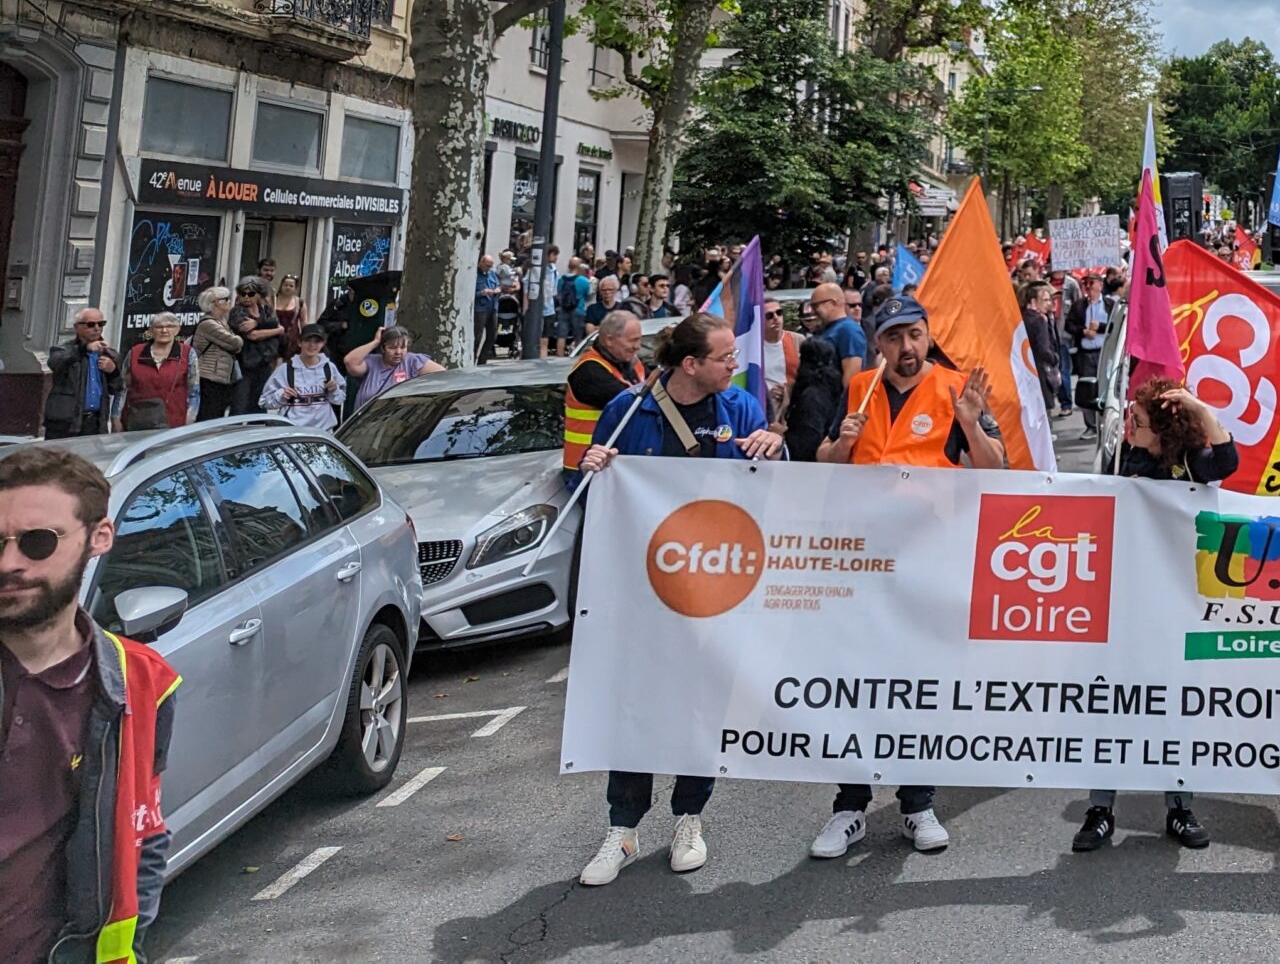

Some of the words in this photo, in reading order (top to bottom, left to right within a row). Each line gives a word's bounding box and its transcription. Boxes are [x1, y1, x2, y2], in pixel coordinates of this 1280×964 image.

[206, 174, 217, 198] À
[219, 181, 258, 202] LOUER
[263, 188, 298, 205] Cellules
[299, 191, 354, 209] Commerciales
[355, 196, 399, 213] DIVISIBLES
[336, 235, 362, 252] Place
[998, 505, 1097, 542] la
[770, 535, 802, 549] UTI
[809, 537, 866, 552] LOIRE
[767, 556, 895, 573] HAUTE-LOIRE
[990, 532, 1097, 593] cgt
[763, 599, 781, 610] AGIR
[781, 599, 801, 610] POUR
[802, 599, 821, 610] TOUS
[765, 585, 803, 596] S'ENGAGER
[804, 586, 824, 597] POUR
[825, 586, 854, 598] CHACUN
[990, 594, 1092, 634] loire
[774, 677, 940, 710] CONTRE
[952, 675, 1168, 715] L'EXTRÊME
[720, 729, 811, 759] POUR
[821, 733, 863, 759] LA
[874, 734, 1083, 763] DEMOCRATIE
[1094, 739, 1133, 765] ET
[1143, 740, 1181, 766] LE
